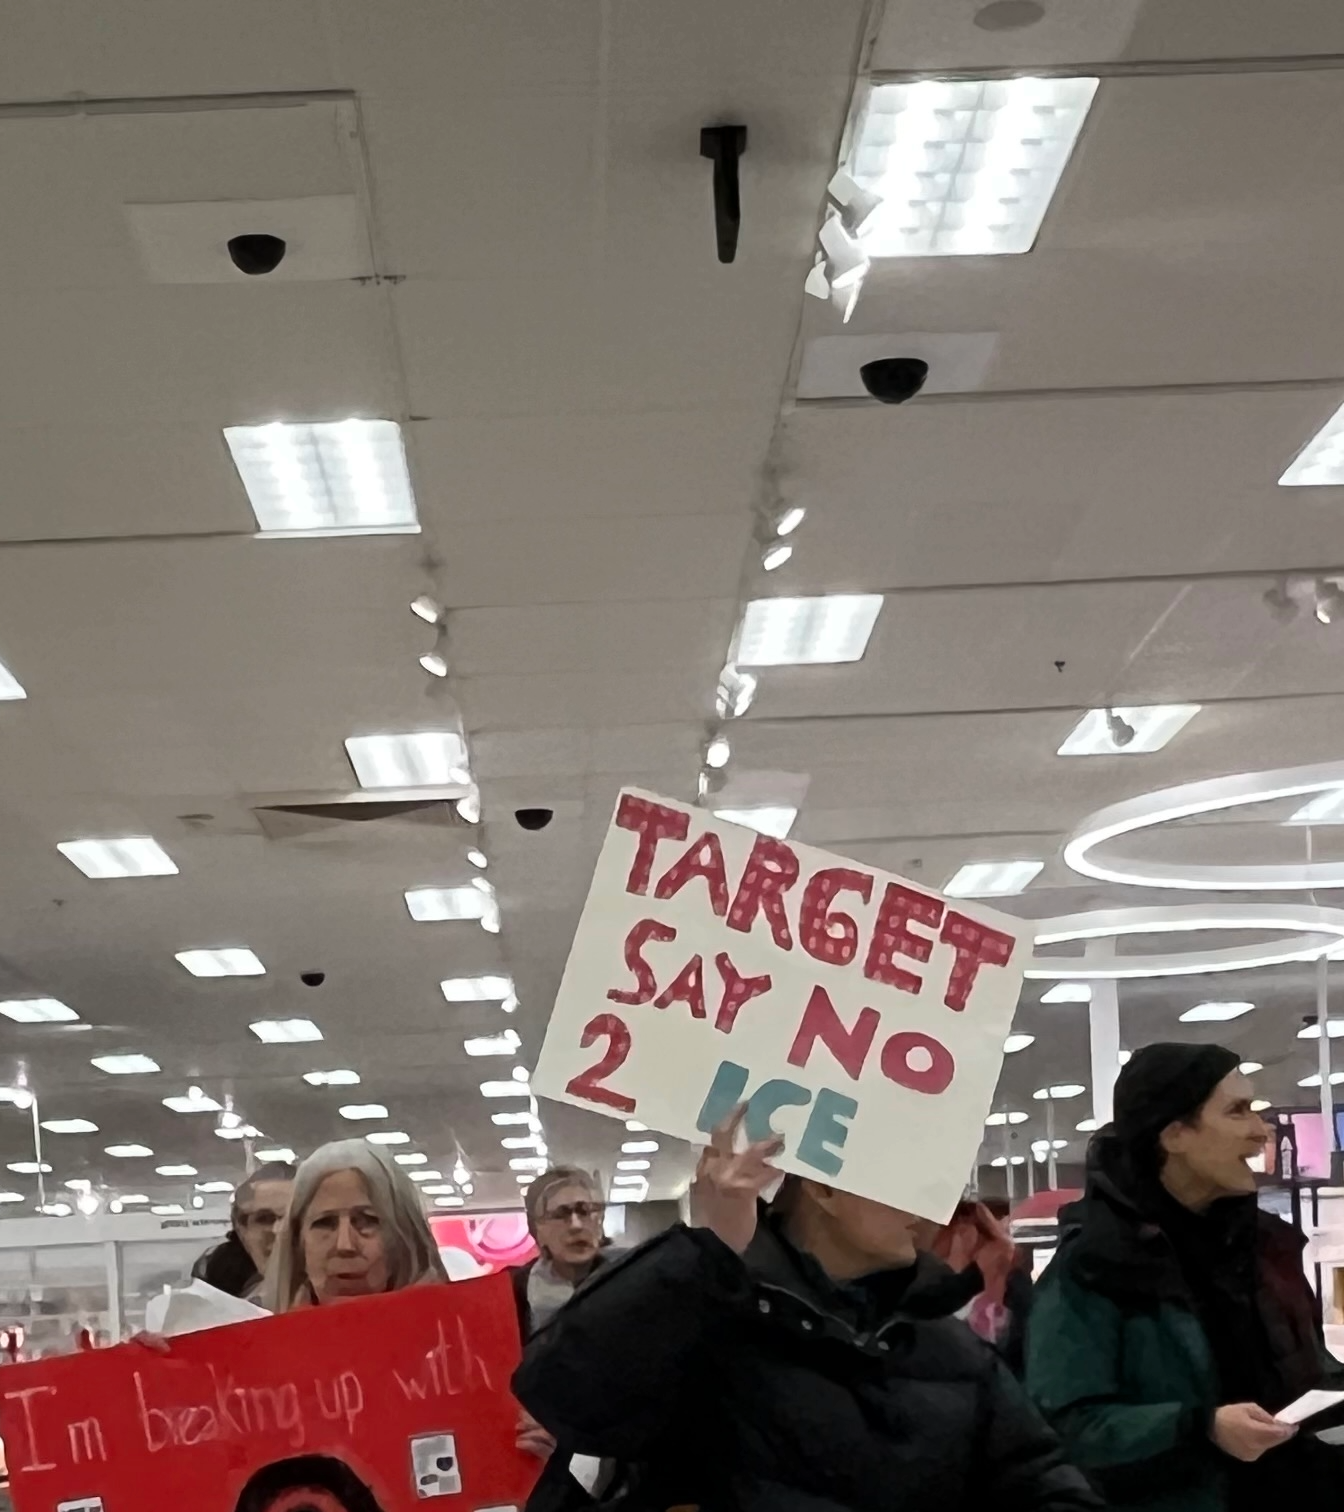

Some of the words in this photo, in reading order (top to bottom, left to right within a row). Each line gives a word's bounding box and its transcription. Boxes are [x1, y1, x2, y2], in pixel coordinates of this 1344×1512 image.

[614, 792, 1017, 1013] TARGET
[606, 918, 773, 1035] SAY
[786, 984, 956, 1095] NO
[564, 1012, 637, 1114] 2
[696, 1060, 859, 1178] ICE
[313, 1370, 364, 1435] up
[391, 1314, 498, 1401] with
